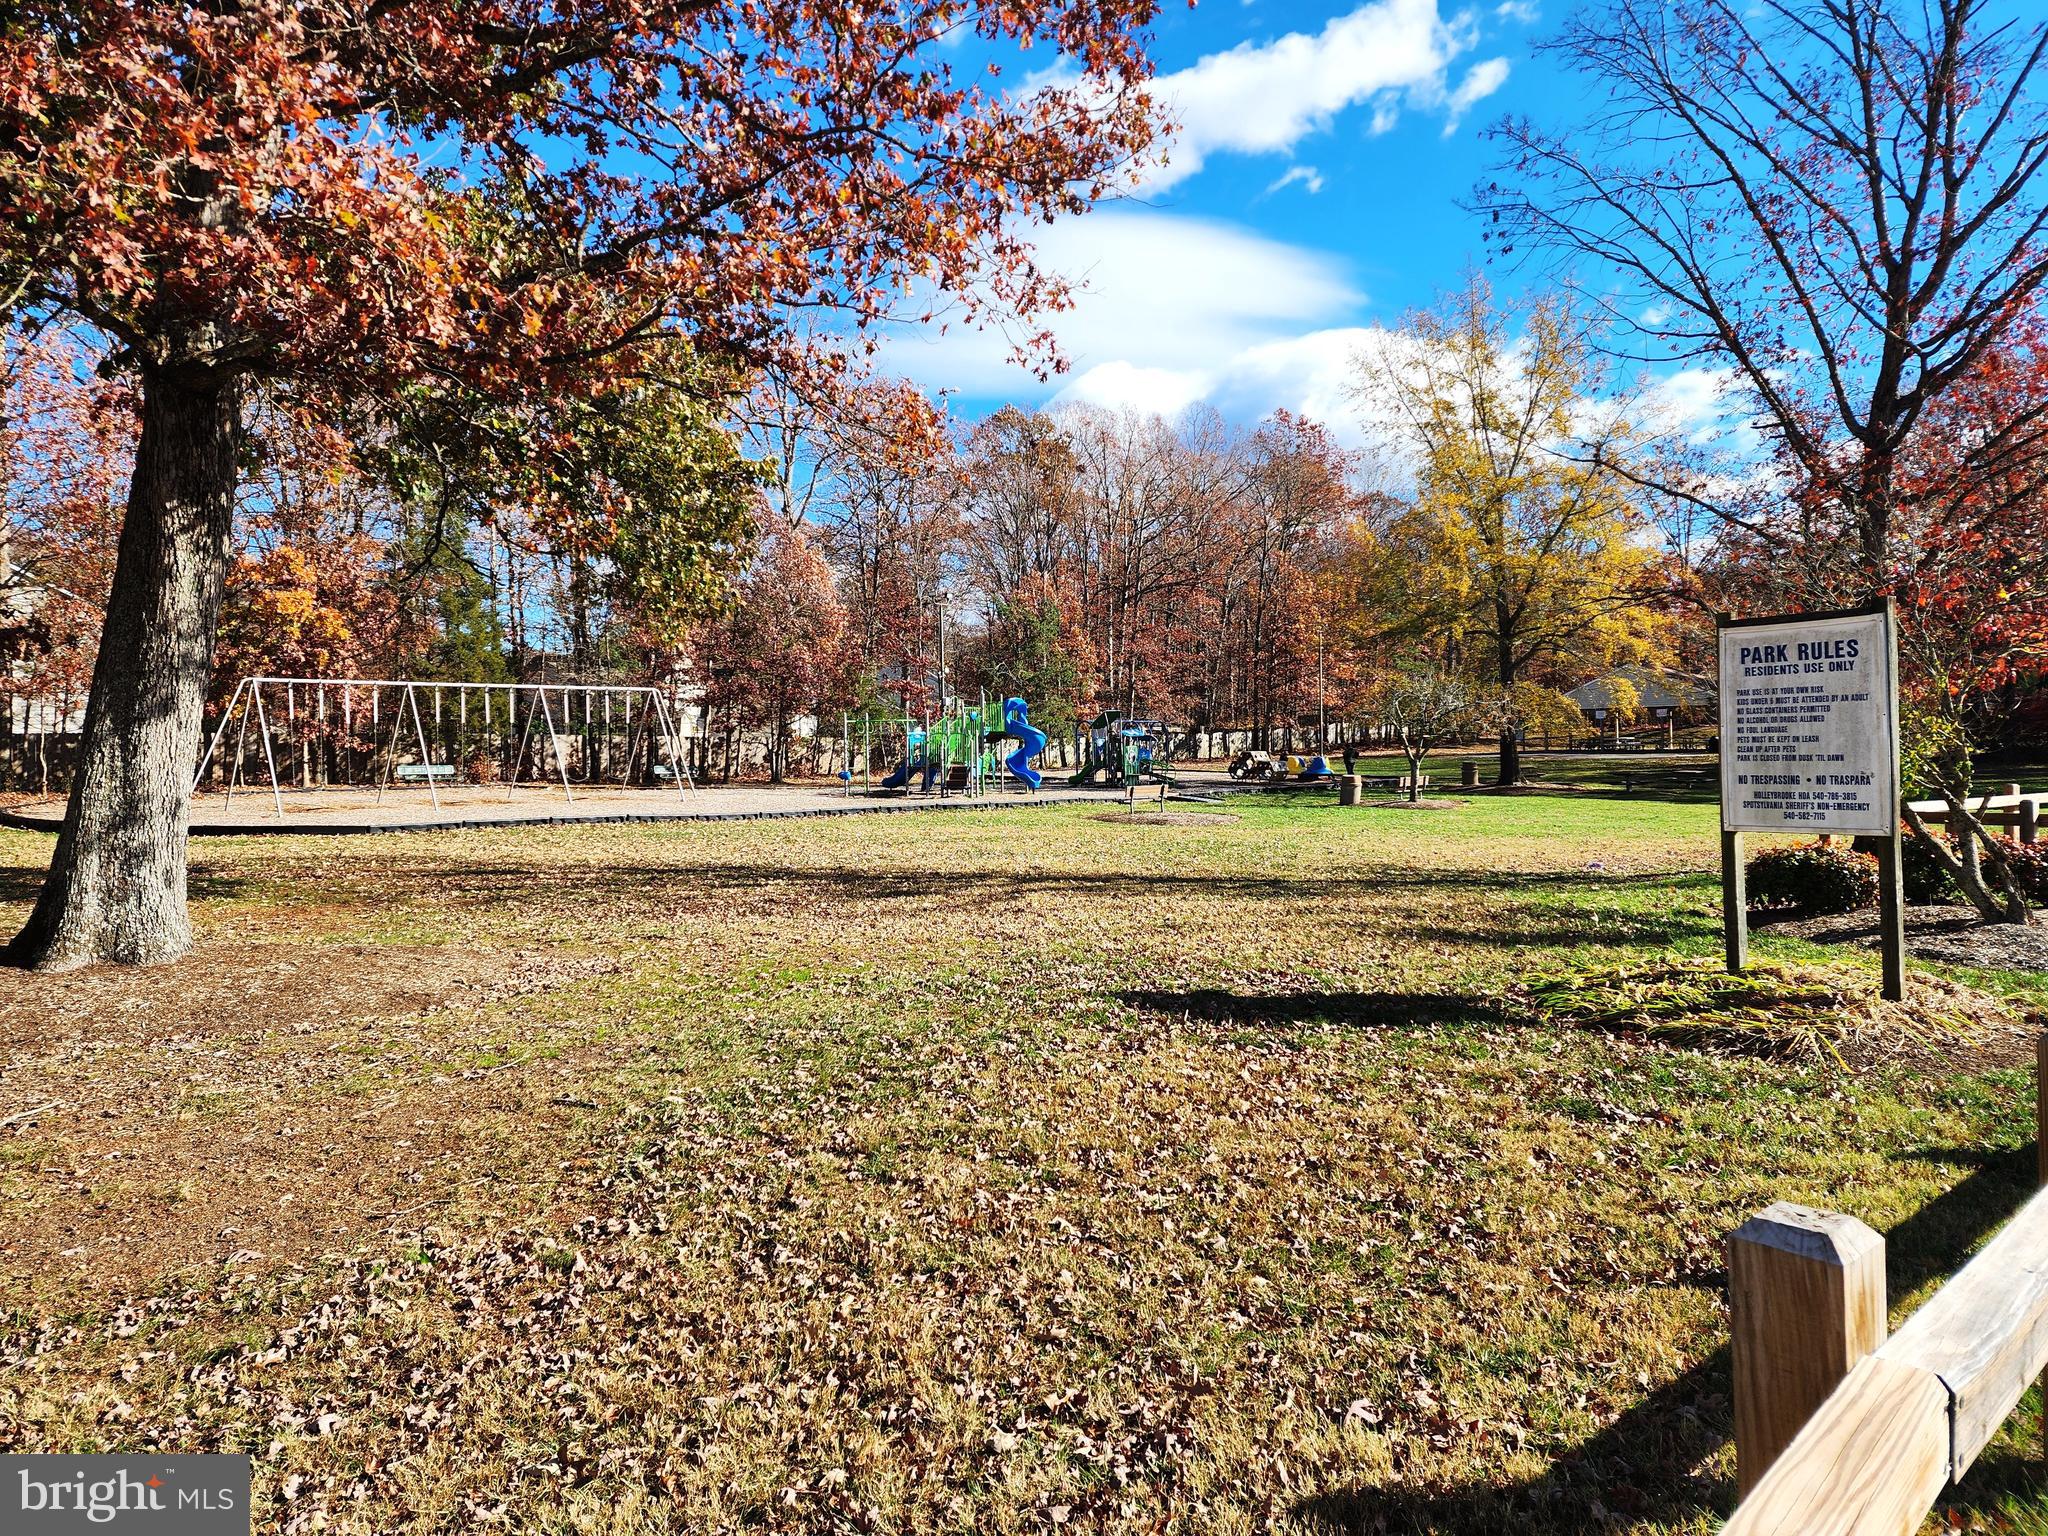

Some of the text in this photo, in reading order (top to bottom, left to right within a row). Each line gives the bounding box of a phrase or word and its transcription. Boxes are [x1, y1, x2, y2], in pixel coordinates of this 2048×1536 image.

[1741, 639, 1859, 664] PARK RULES
[1745, 661, 1854, 676] RESIDENTS USE ONLY
[1738, 775, 1871, 785] NO TRESPASSING NO TRASPARA
[1754, 791, 1796, 800] HOLLEYBROOKE
[1743, 801, 1783, 809] SPOTSYLVANIA
[1817, 803, 1870, 811] NON-EMERGENCY
